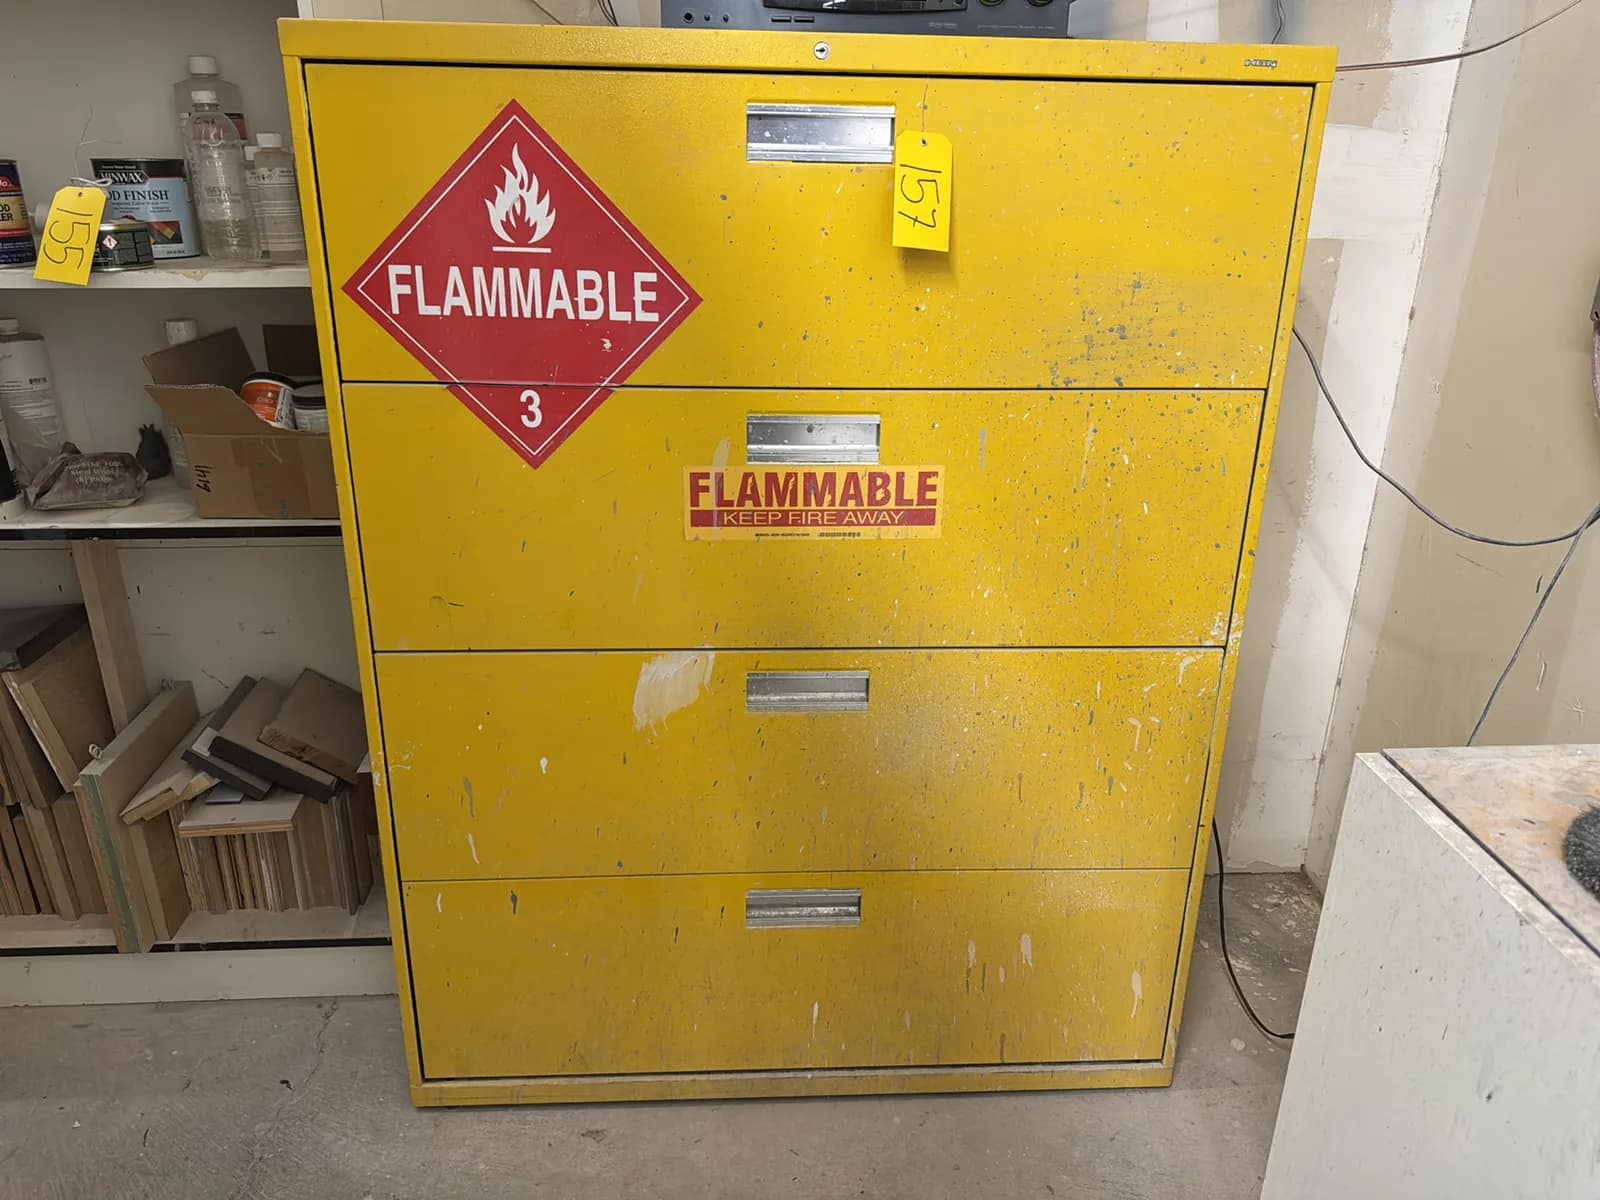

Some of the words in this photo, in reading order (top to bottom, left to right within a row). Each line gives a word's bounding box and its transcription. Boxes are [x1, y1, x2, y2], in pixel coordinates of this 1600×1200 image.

[123, 190, 169, 201] FINISH
[898, 163, 942, 228] 157
[0, 212, 14, 221] ER
[43, 207, 93, 270] 155
[387, 264, 660, 323] FLAMMABLE
[519, 389, 543, 429] 3
[689, 471, 939, 508] FLAMMABLE
[723, 510, 782, 526] KEEP
[788, 510, 838, 525] FIRE
[842, 509, 905, 525] AWAY
